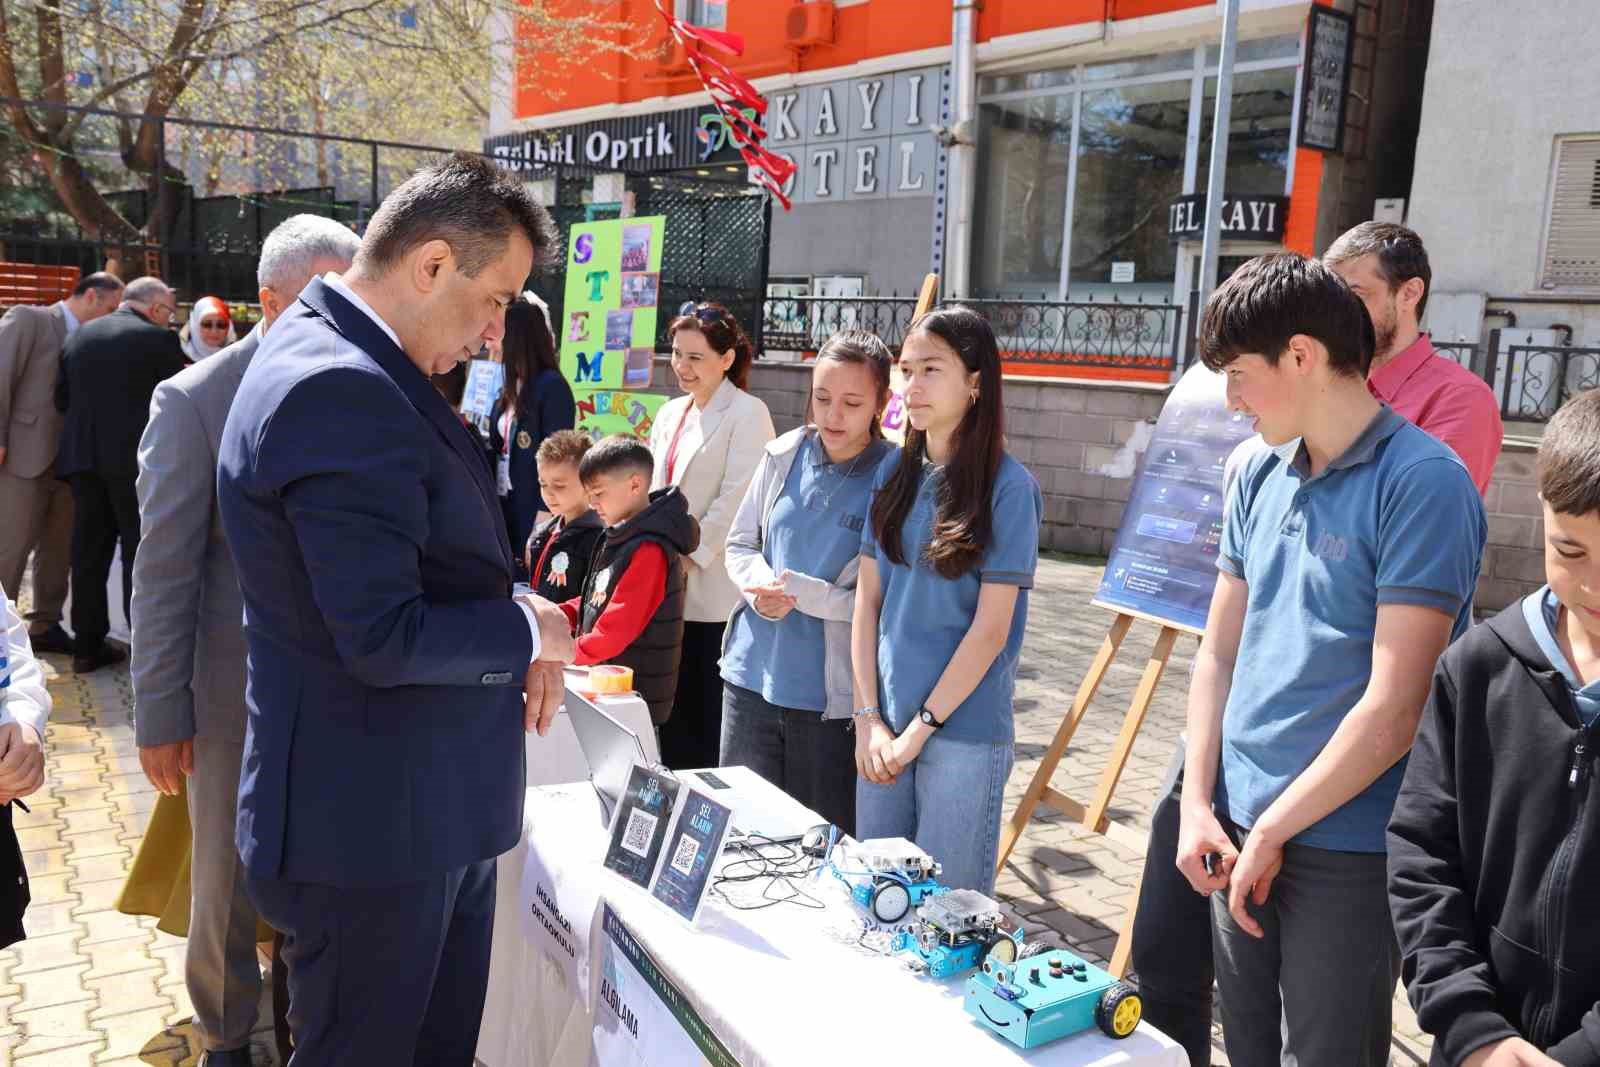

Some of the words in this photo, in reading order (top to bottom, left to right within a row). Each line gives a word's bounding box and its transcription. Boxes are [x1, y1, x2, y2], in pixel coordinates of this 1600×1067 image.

[773, 76, 923, 141] KAYI
[585, 121, 674, 169] Optik
[568, 232, 610, 383] STEM
[531, 903, 575, 958] ORTAOKULU
[600, 979, 638, 1040] ALGILAMA
